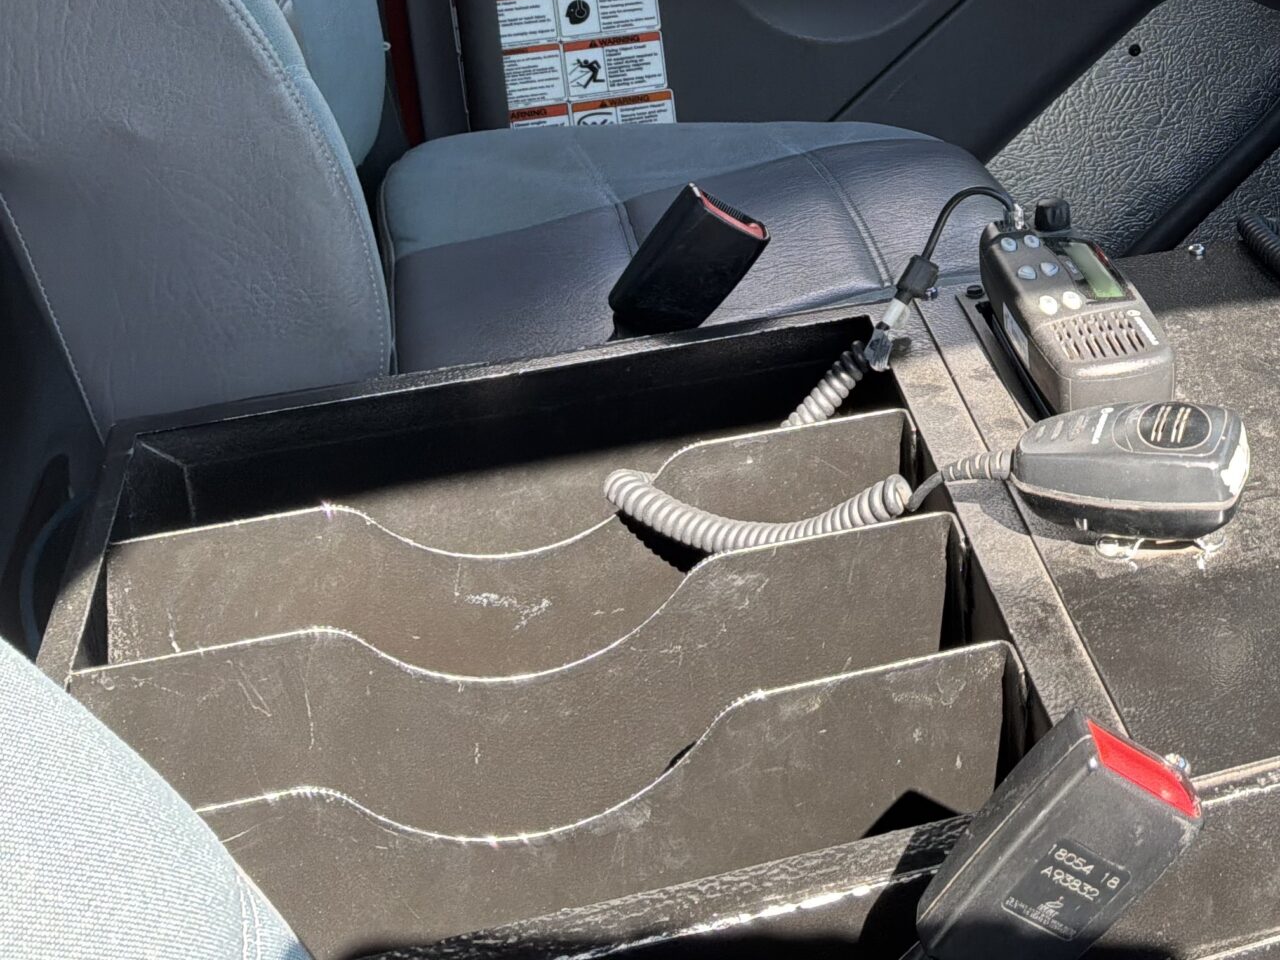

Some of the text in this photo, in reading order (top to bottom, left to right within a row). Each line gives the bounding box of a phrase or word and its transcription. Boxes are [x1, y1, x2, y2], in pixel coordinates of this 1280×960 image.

[598, 35, 640, 47] WARNING
[609, 94, 650, 108] WARNING
[1040, 865, 1100, 902] A93832
[1100, 872, 1121, 890] 18
